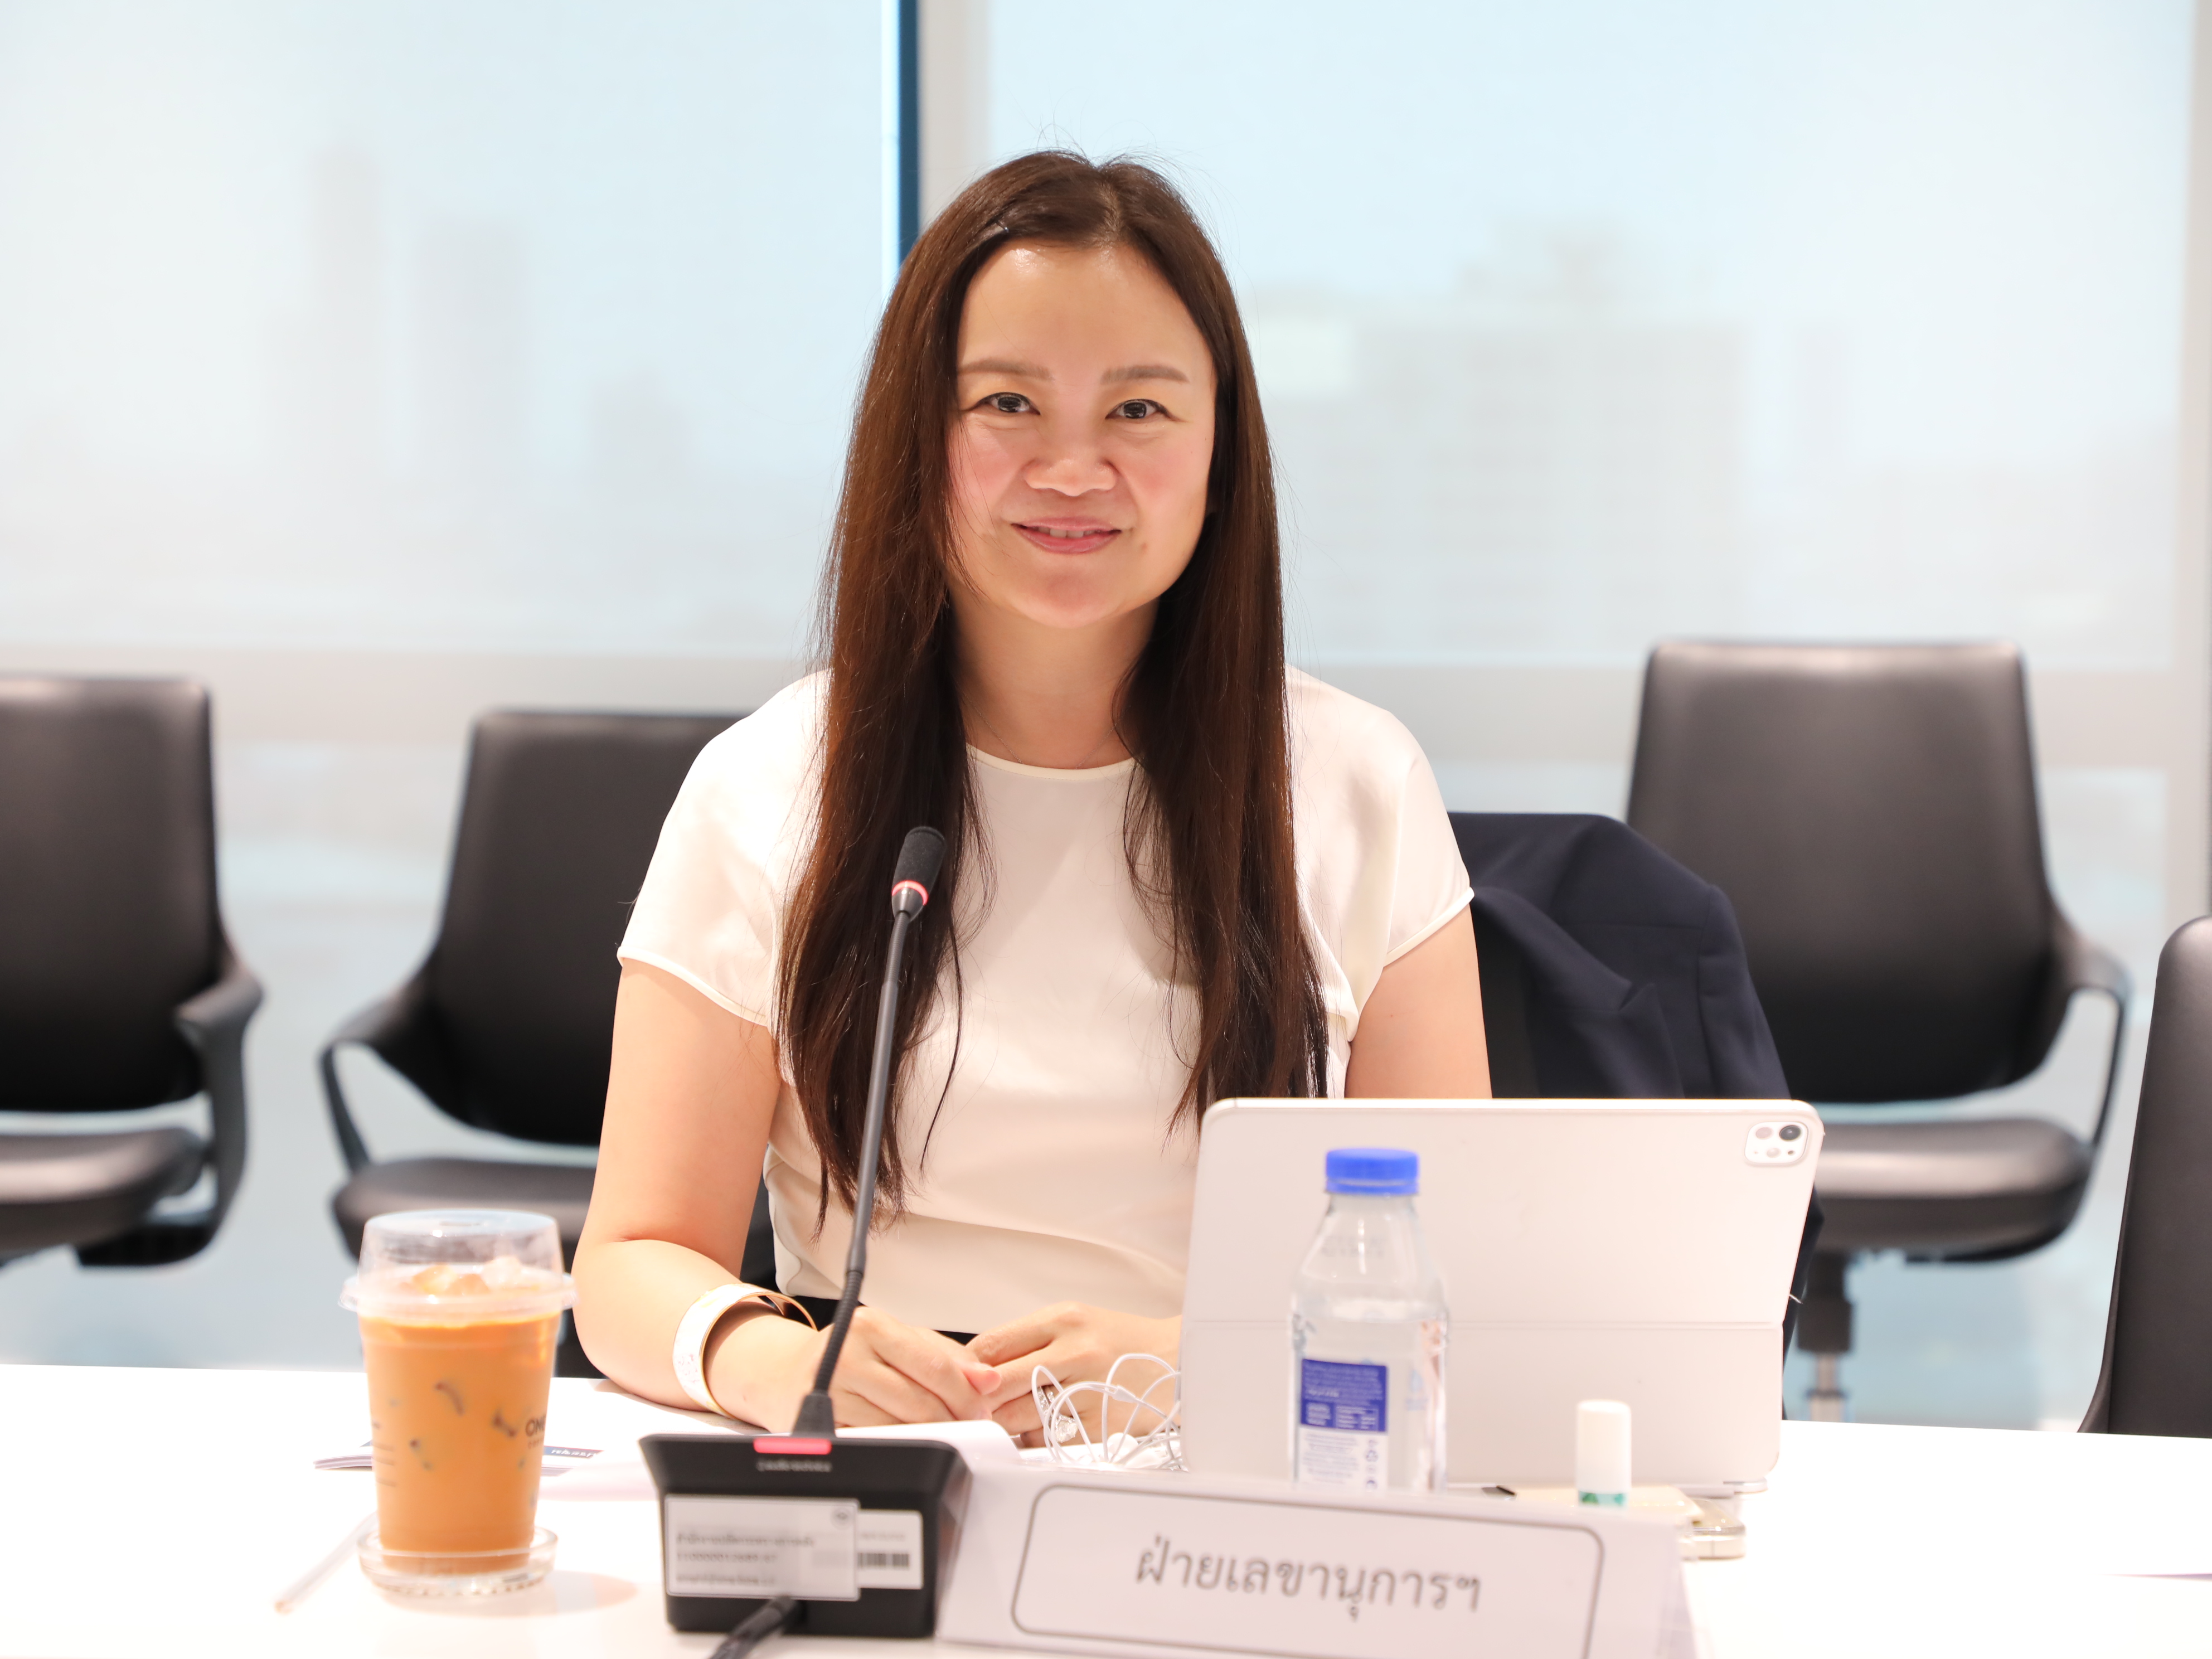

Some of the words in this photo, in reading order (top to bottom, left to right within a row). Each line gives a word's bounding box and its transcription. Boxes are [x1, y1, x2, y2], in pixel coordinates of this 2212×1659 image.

[1135, 1533, 1482, 1623] ฝ่ายเลขานุการฯ
